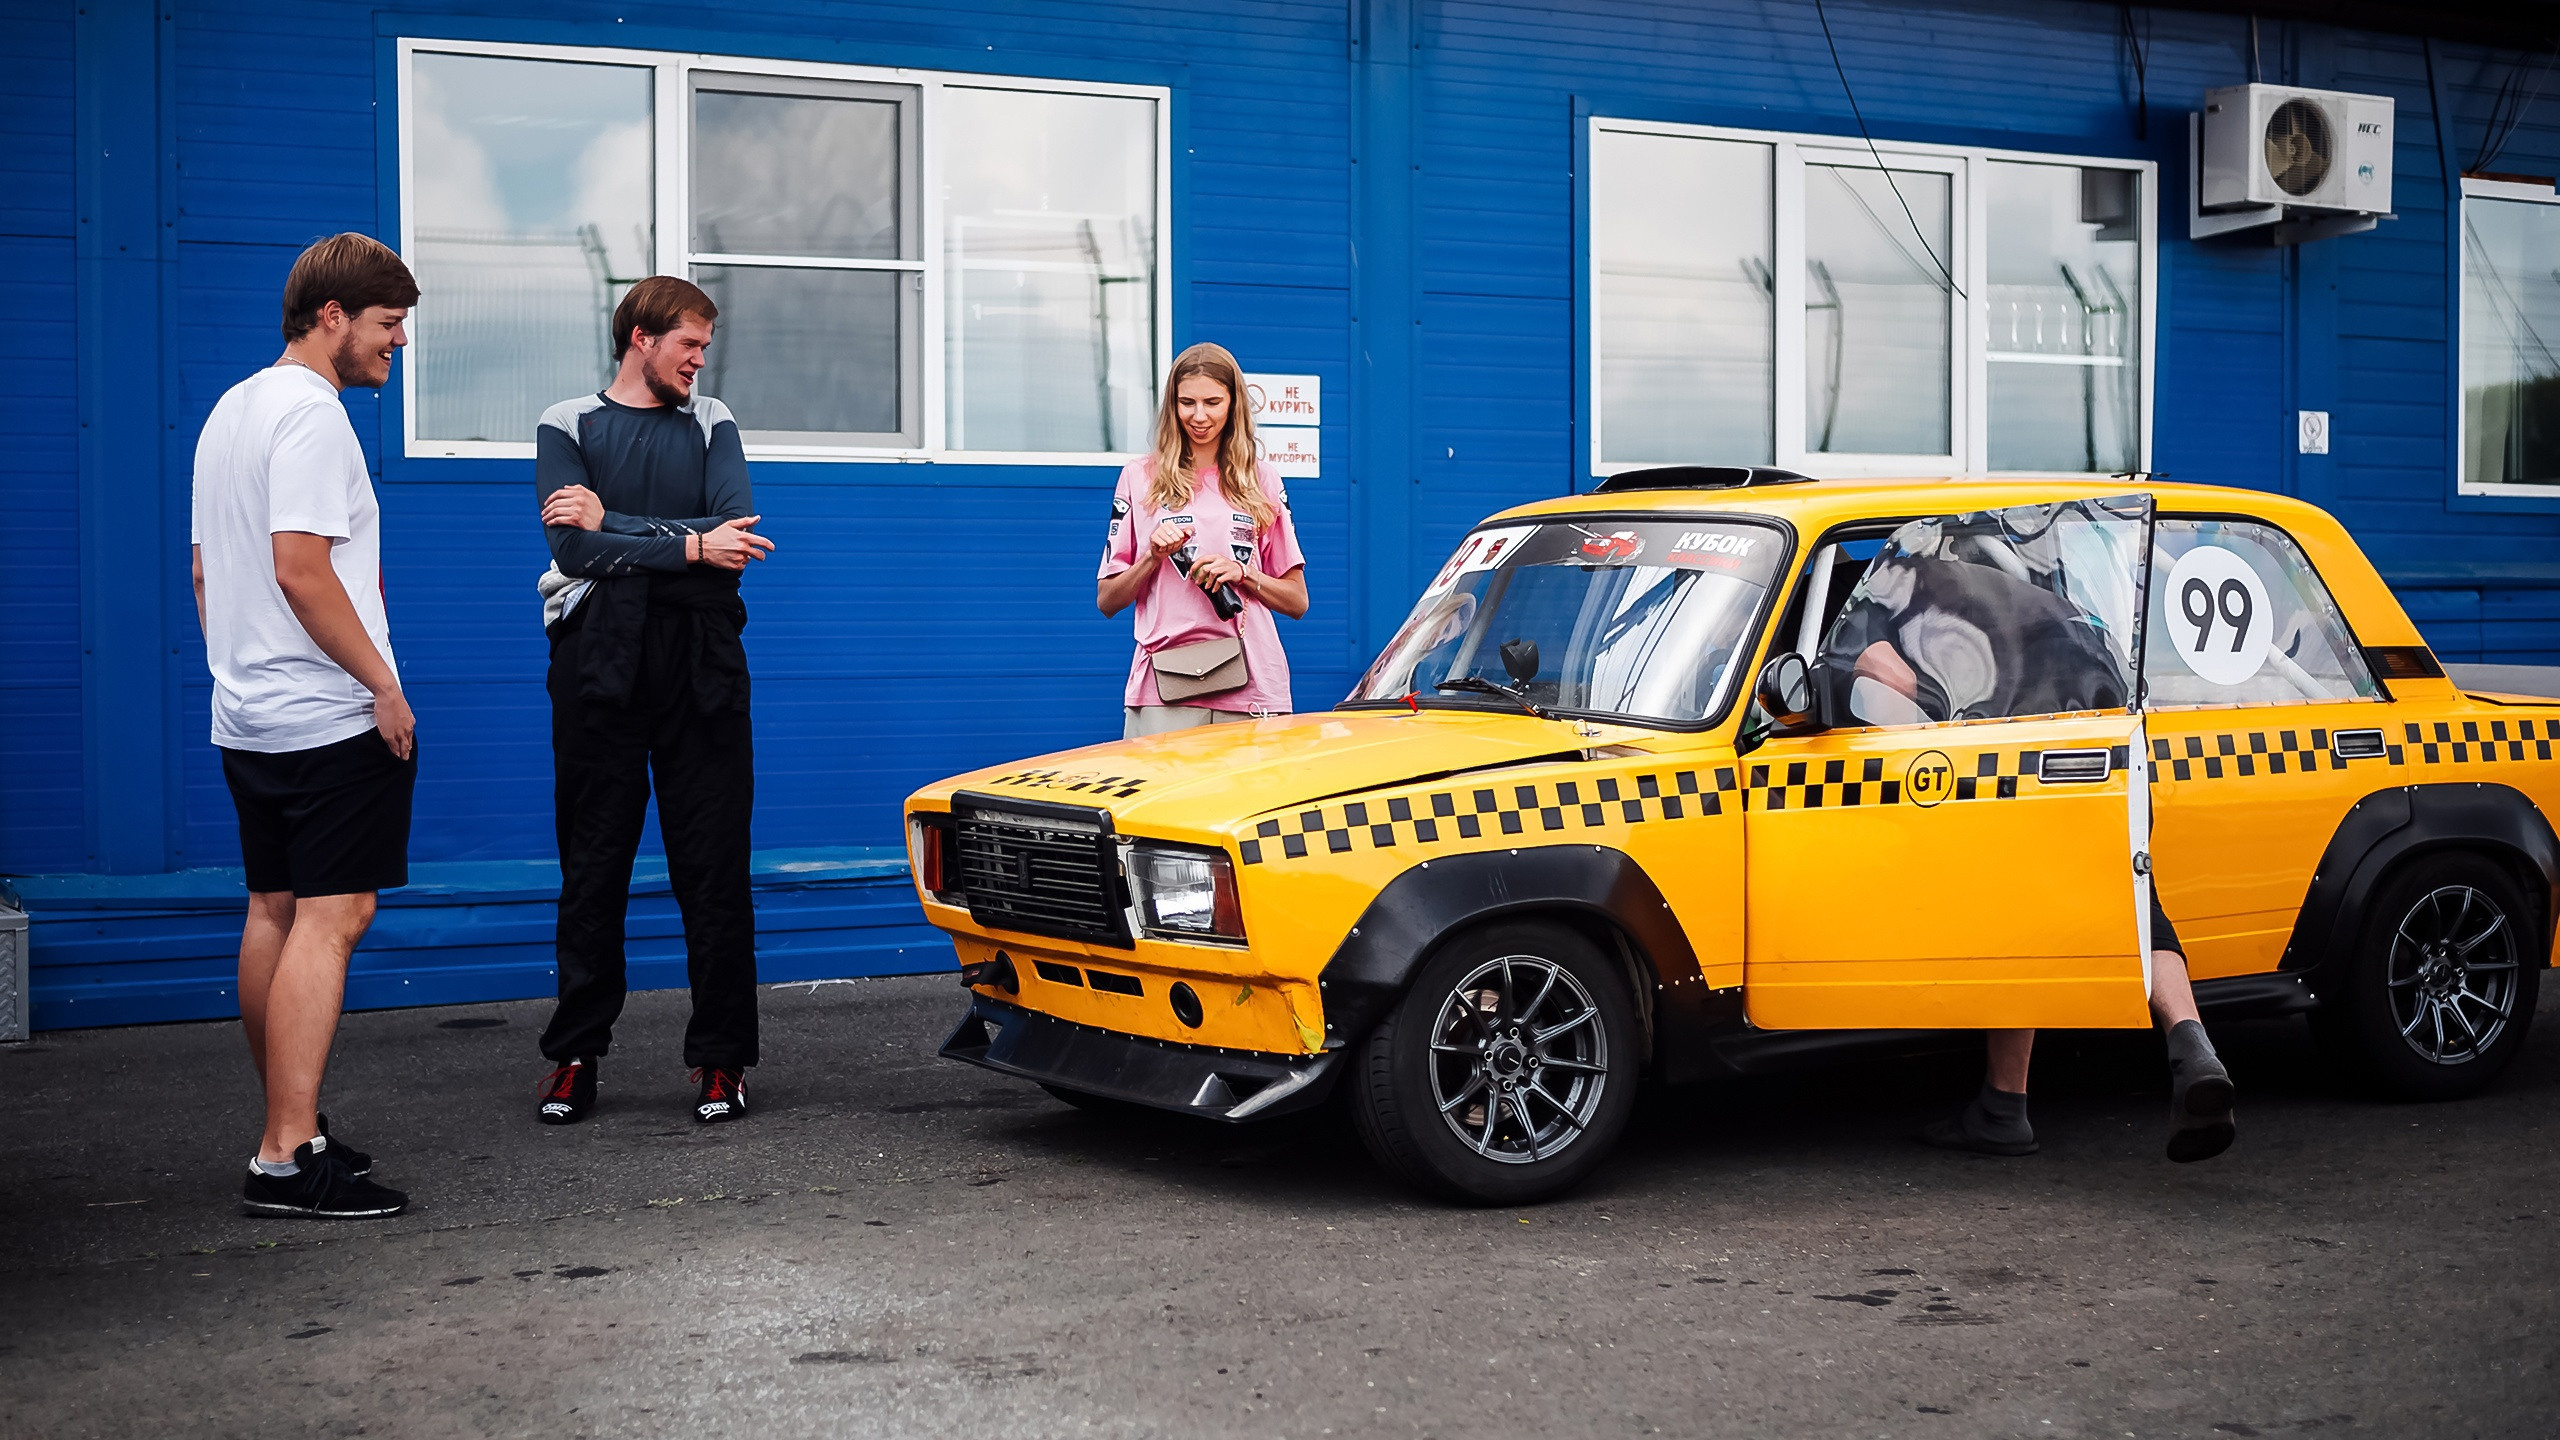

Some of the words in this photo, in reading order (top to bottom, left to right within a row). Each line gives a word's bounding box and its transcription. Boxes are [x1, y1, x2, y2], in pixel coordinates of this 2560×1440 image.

[1285, 386, 1300, 399] НЕ
[1269, 401, 1315, 414] КУРИТЬ
[1287, 442, 1298, 452] НЕ
[1268, 453, 1317, 463] МУСОРИТЬ
[1674, 532, 1756, 557] КУБОК
[2181, 577, 2253, 653] 99
[1914, 766, 1948, 792] GT
